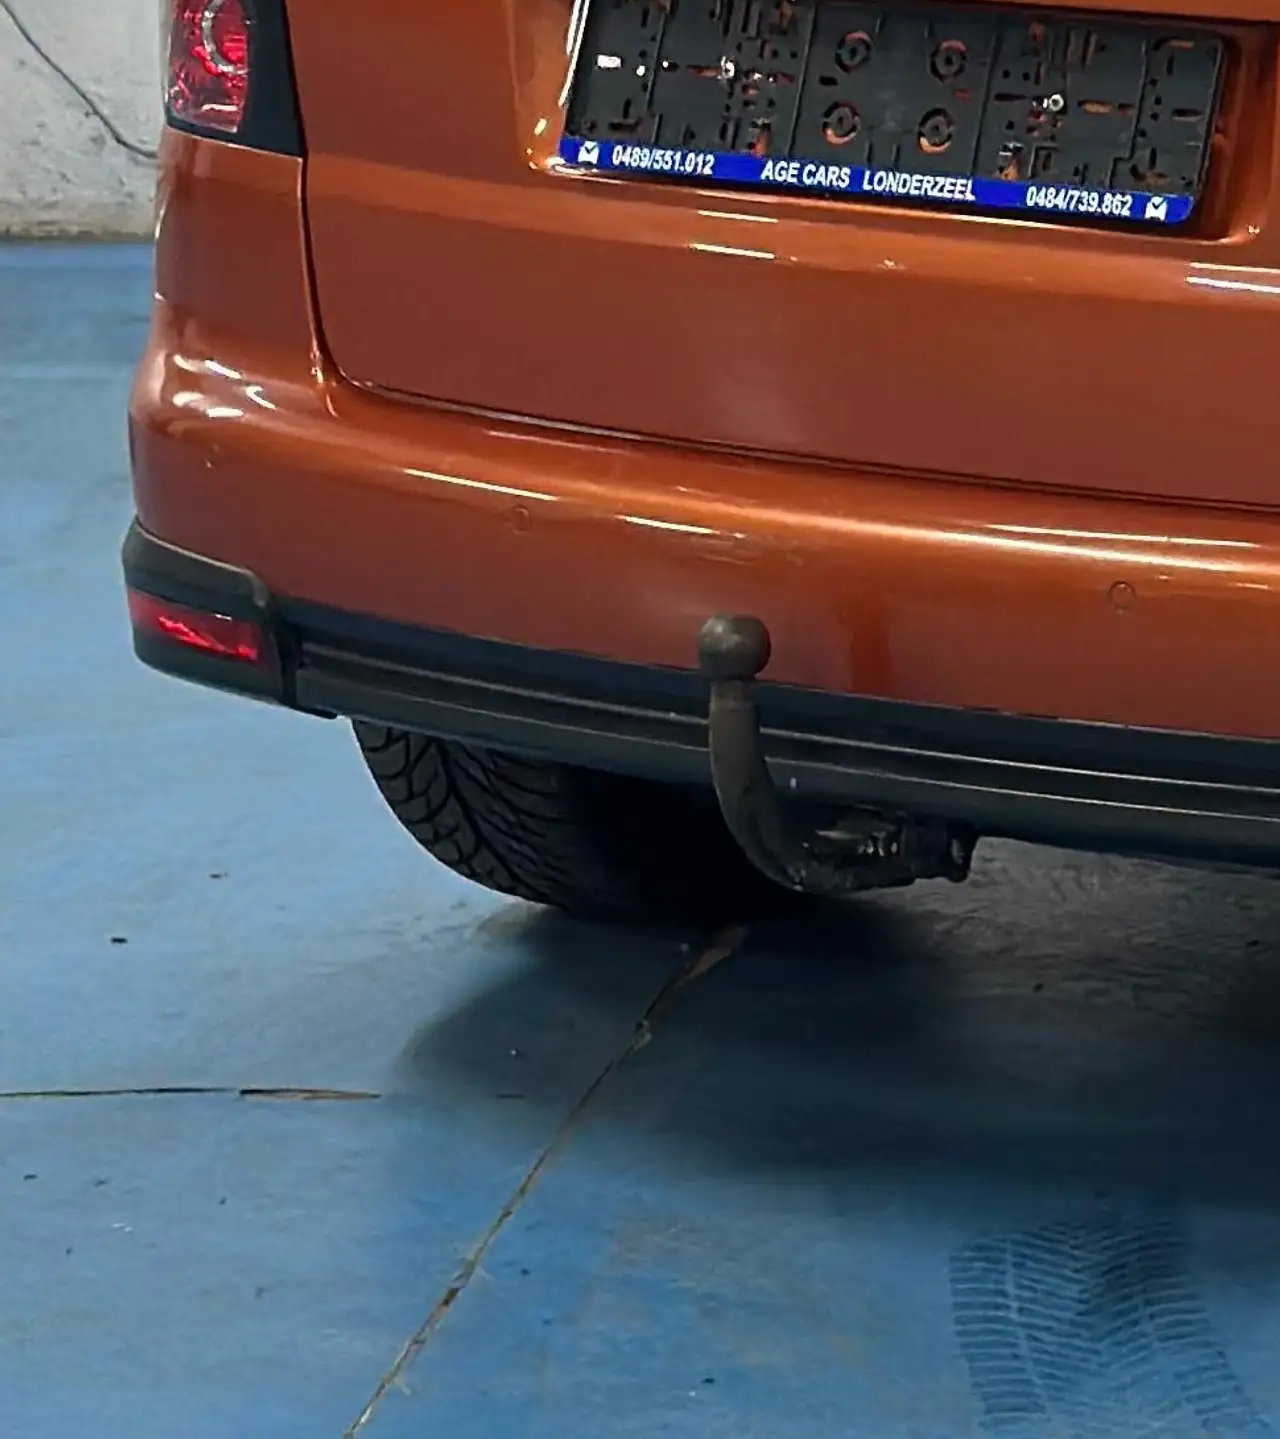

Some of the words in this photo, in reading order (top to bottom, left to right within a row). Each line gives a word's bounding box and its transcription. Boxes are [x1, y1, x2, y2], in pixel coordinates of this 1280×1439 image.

[611, 144, 714, 175] 0489/551.012
[760, 159, 801, 183] AGE
[801, 163, 851, 189] CARS
[862, 170, 976, 202] LONDERZEEL
[1025, 185, 1133, 217] 0484/739.862
